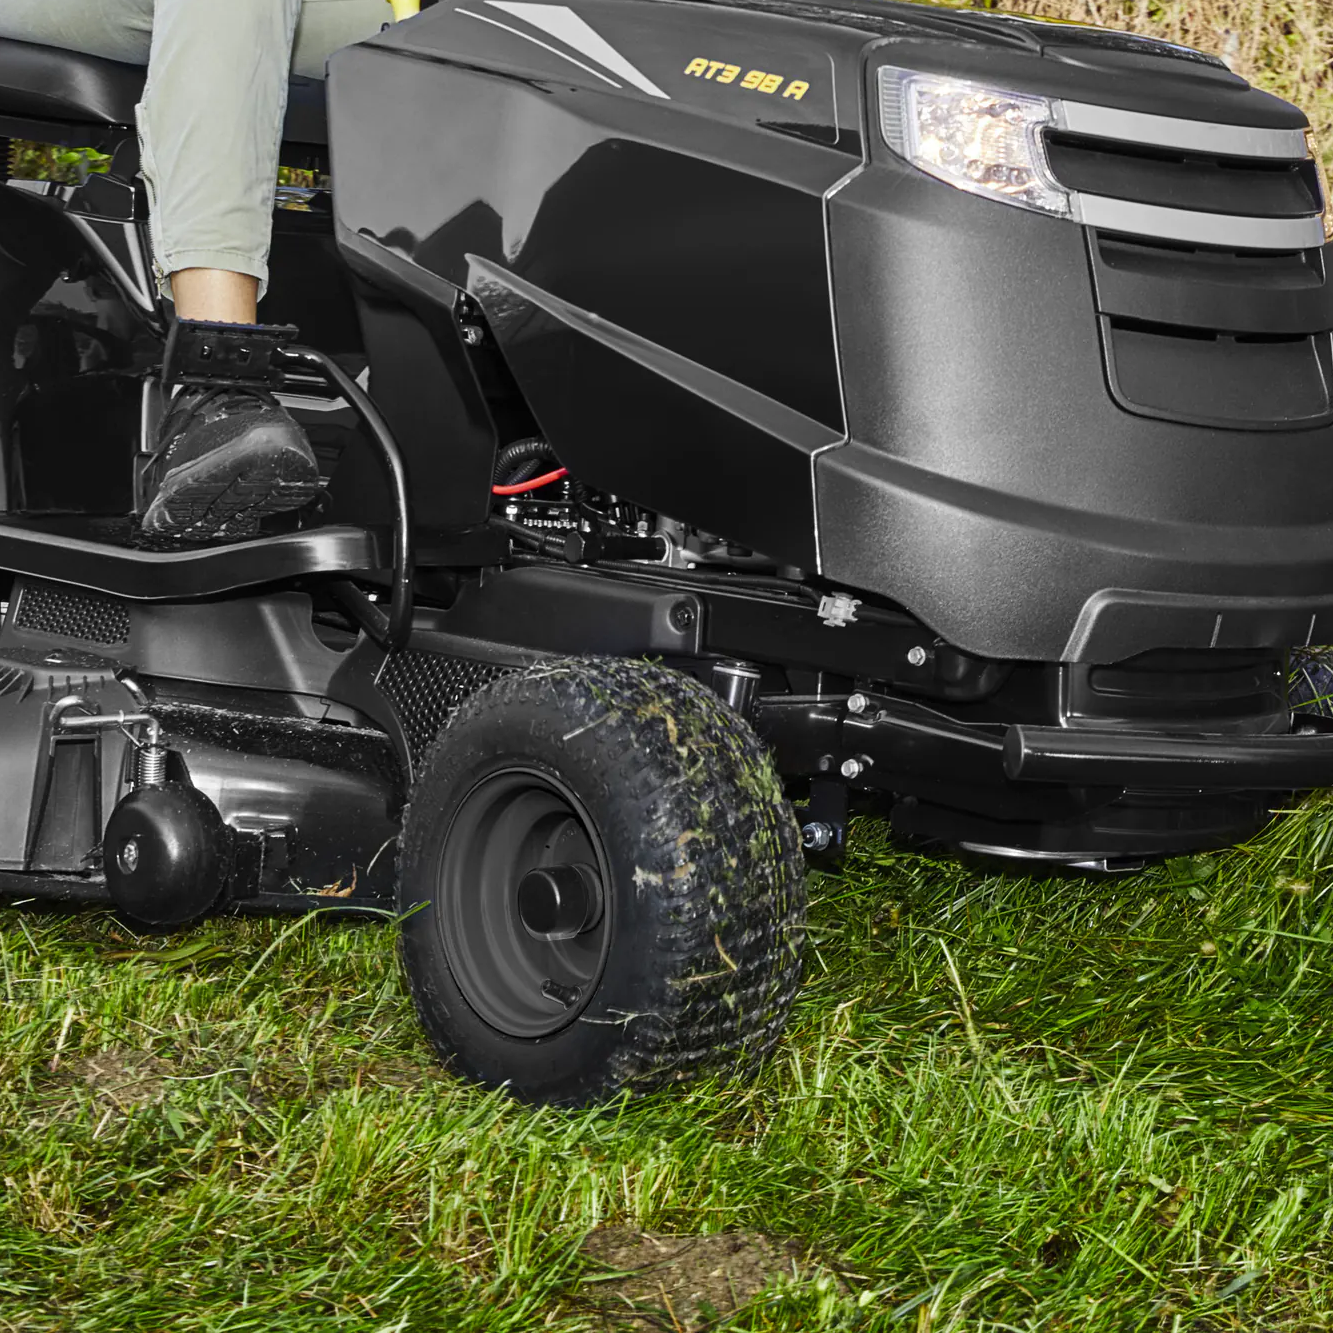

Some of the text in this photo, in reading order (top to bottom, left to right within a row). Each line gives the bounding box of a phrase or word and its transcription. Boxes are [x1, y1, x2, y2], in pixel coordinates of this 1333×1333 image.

[684, 57, 810, 100] AT3 98 A
